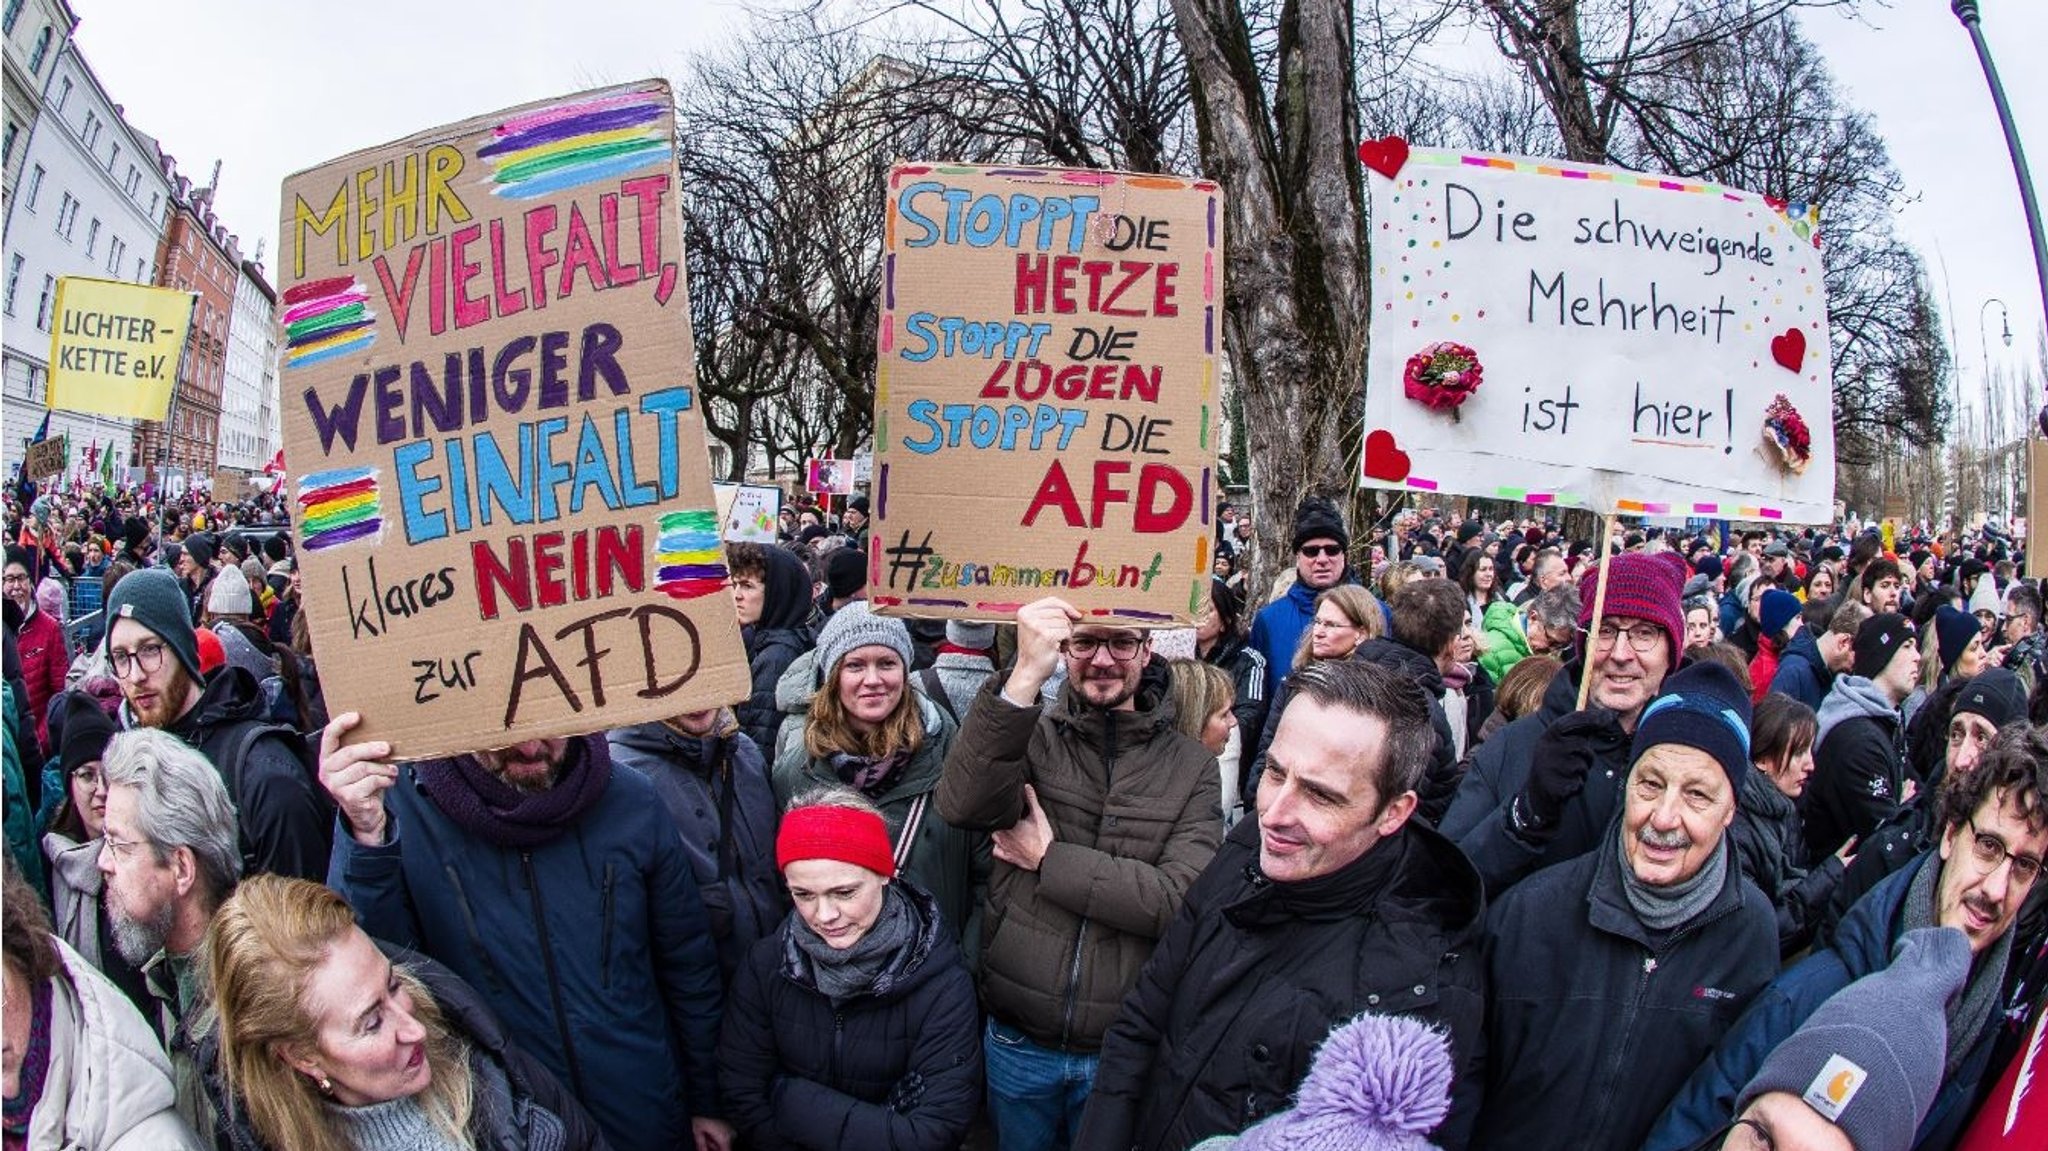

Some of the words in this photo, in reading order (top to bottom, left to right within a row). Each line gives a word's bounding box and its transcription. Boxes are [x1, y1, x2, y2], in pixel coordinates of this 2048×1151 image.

[294, 144, 473, 279] MEHR
[899, 181, 1100, 253] STOPPT
[1104, 214, 1171, 251] DIE
[1445, 183, 1537, 242] Die
[1574, 199, 1774, 275] schweigende
[372, 173, 678, 344] VIELFALT,
[1014, 253, 1179, 317] HETZE
[900, 312, 1051, 362] STOPPT
[1065, 325, 1138, 361] DIE
[1528, 269, 1735, 344] Mehrheit
[60, 345, 128, 376] KETTE
[133, 355, 166, 380] e.V.
[303, 322, 630, 456] WENIGER
[979, 359, 1164, 403] LÜGEN
[903, 399, 1089, 454] STOPPT
[1100, 413, 1173, 454] DIE
[1522, 385, 1580, 434] ist
[1633, 381, 1735, 455] hier!
[393, 386, 693, 544] EINFALT
[1020, 458, 1194, 534] AFD
[341, 556, 458, 639] klares
[470, 524, 645, 620] NEIN
[885, 529, 1162, 592] #zusammenbunt
[411, 650, 482, 704] zur
[503, 604, 701, 729] AFD
